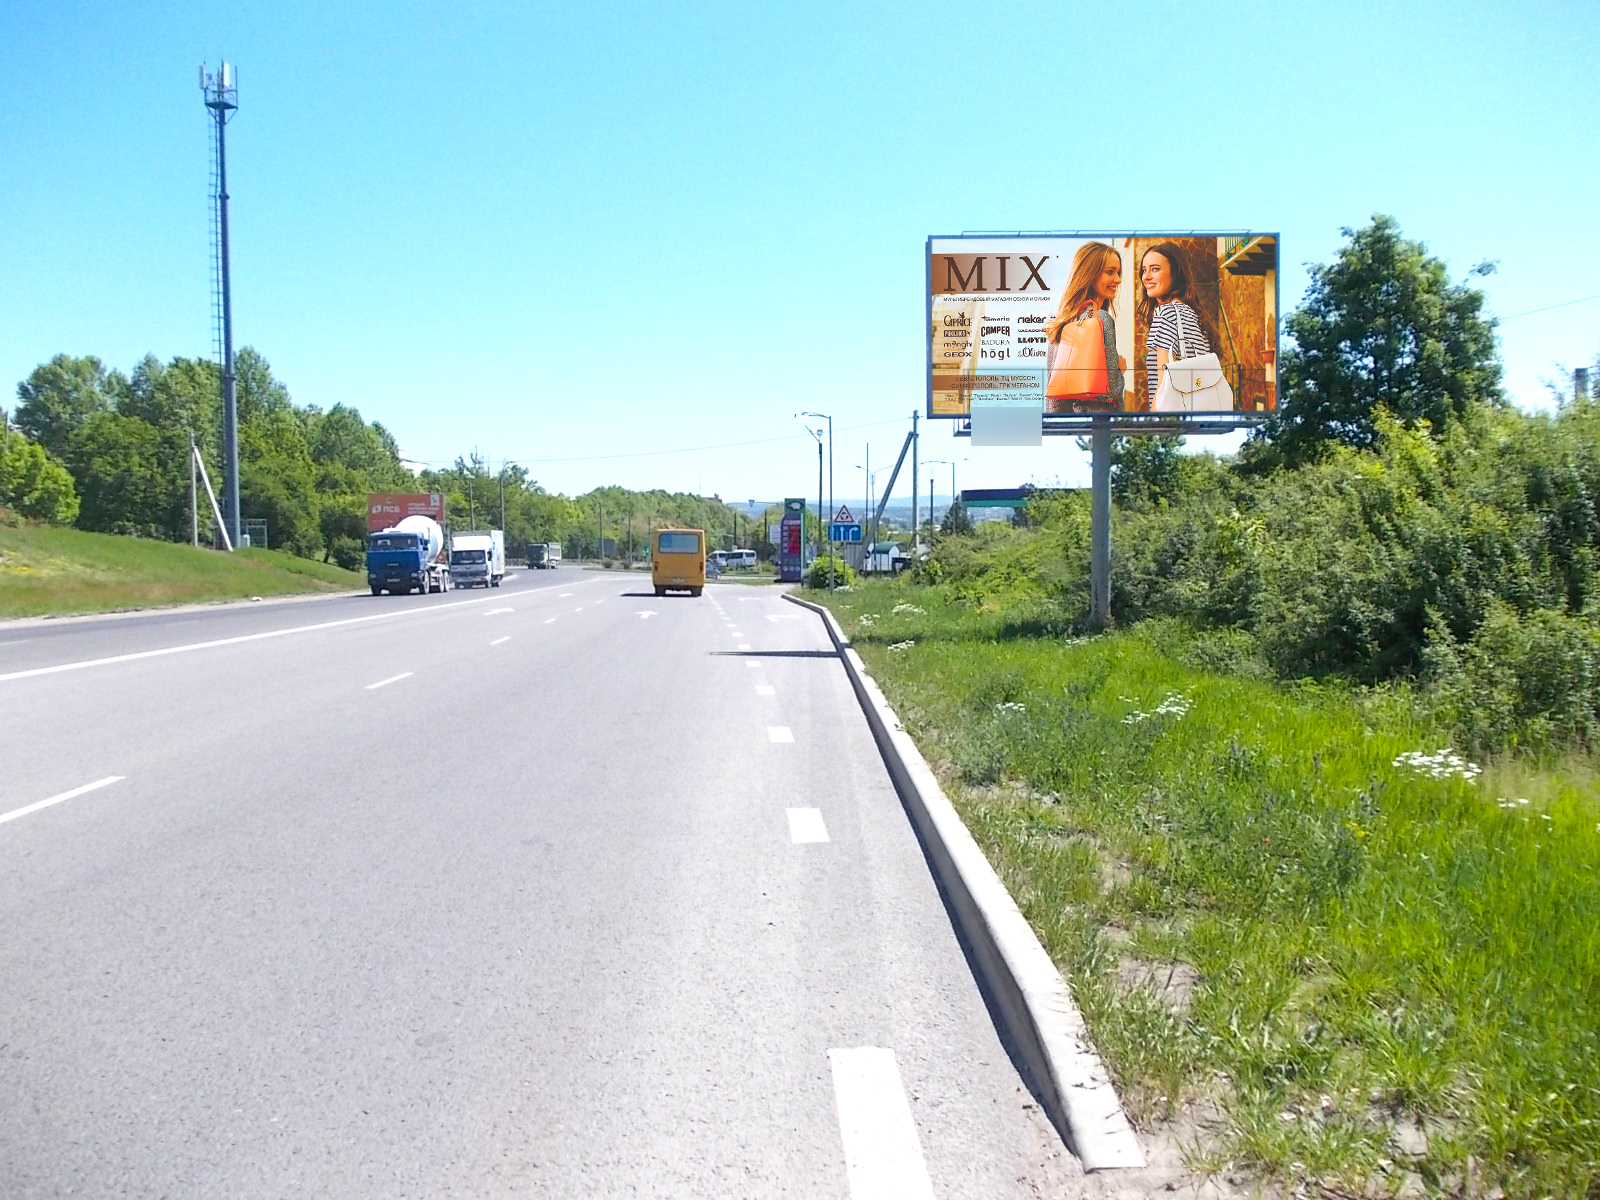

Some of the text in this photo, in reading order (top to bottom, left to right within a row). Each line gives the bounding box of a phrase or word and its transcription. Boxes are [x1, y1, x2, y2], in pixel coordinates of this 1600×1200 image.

[943, 255, 1051, 292] MIX
[1017, 314, 1047, 324] rieker
[981, 326, 1011, 337] CAMPER
